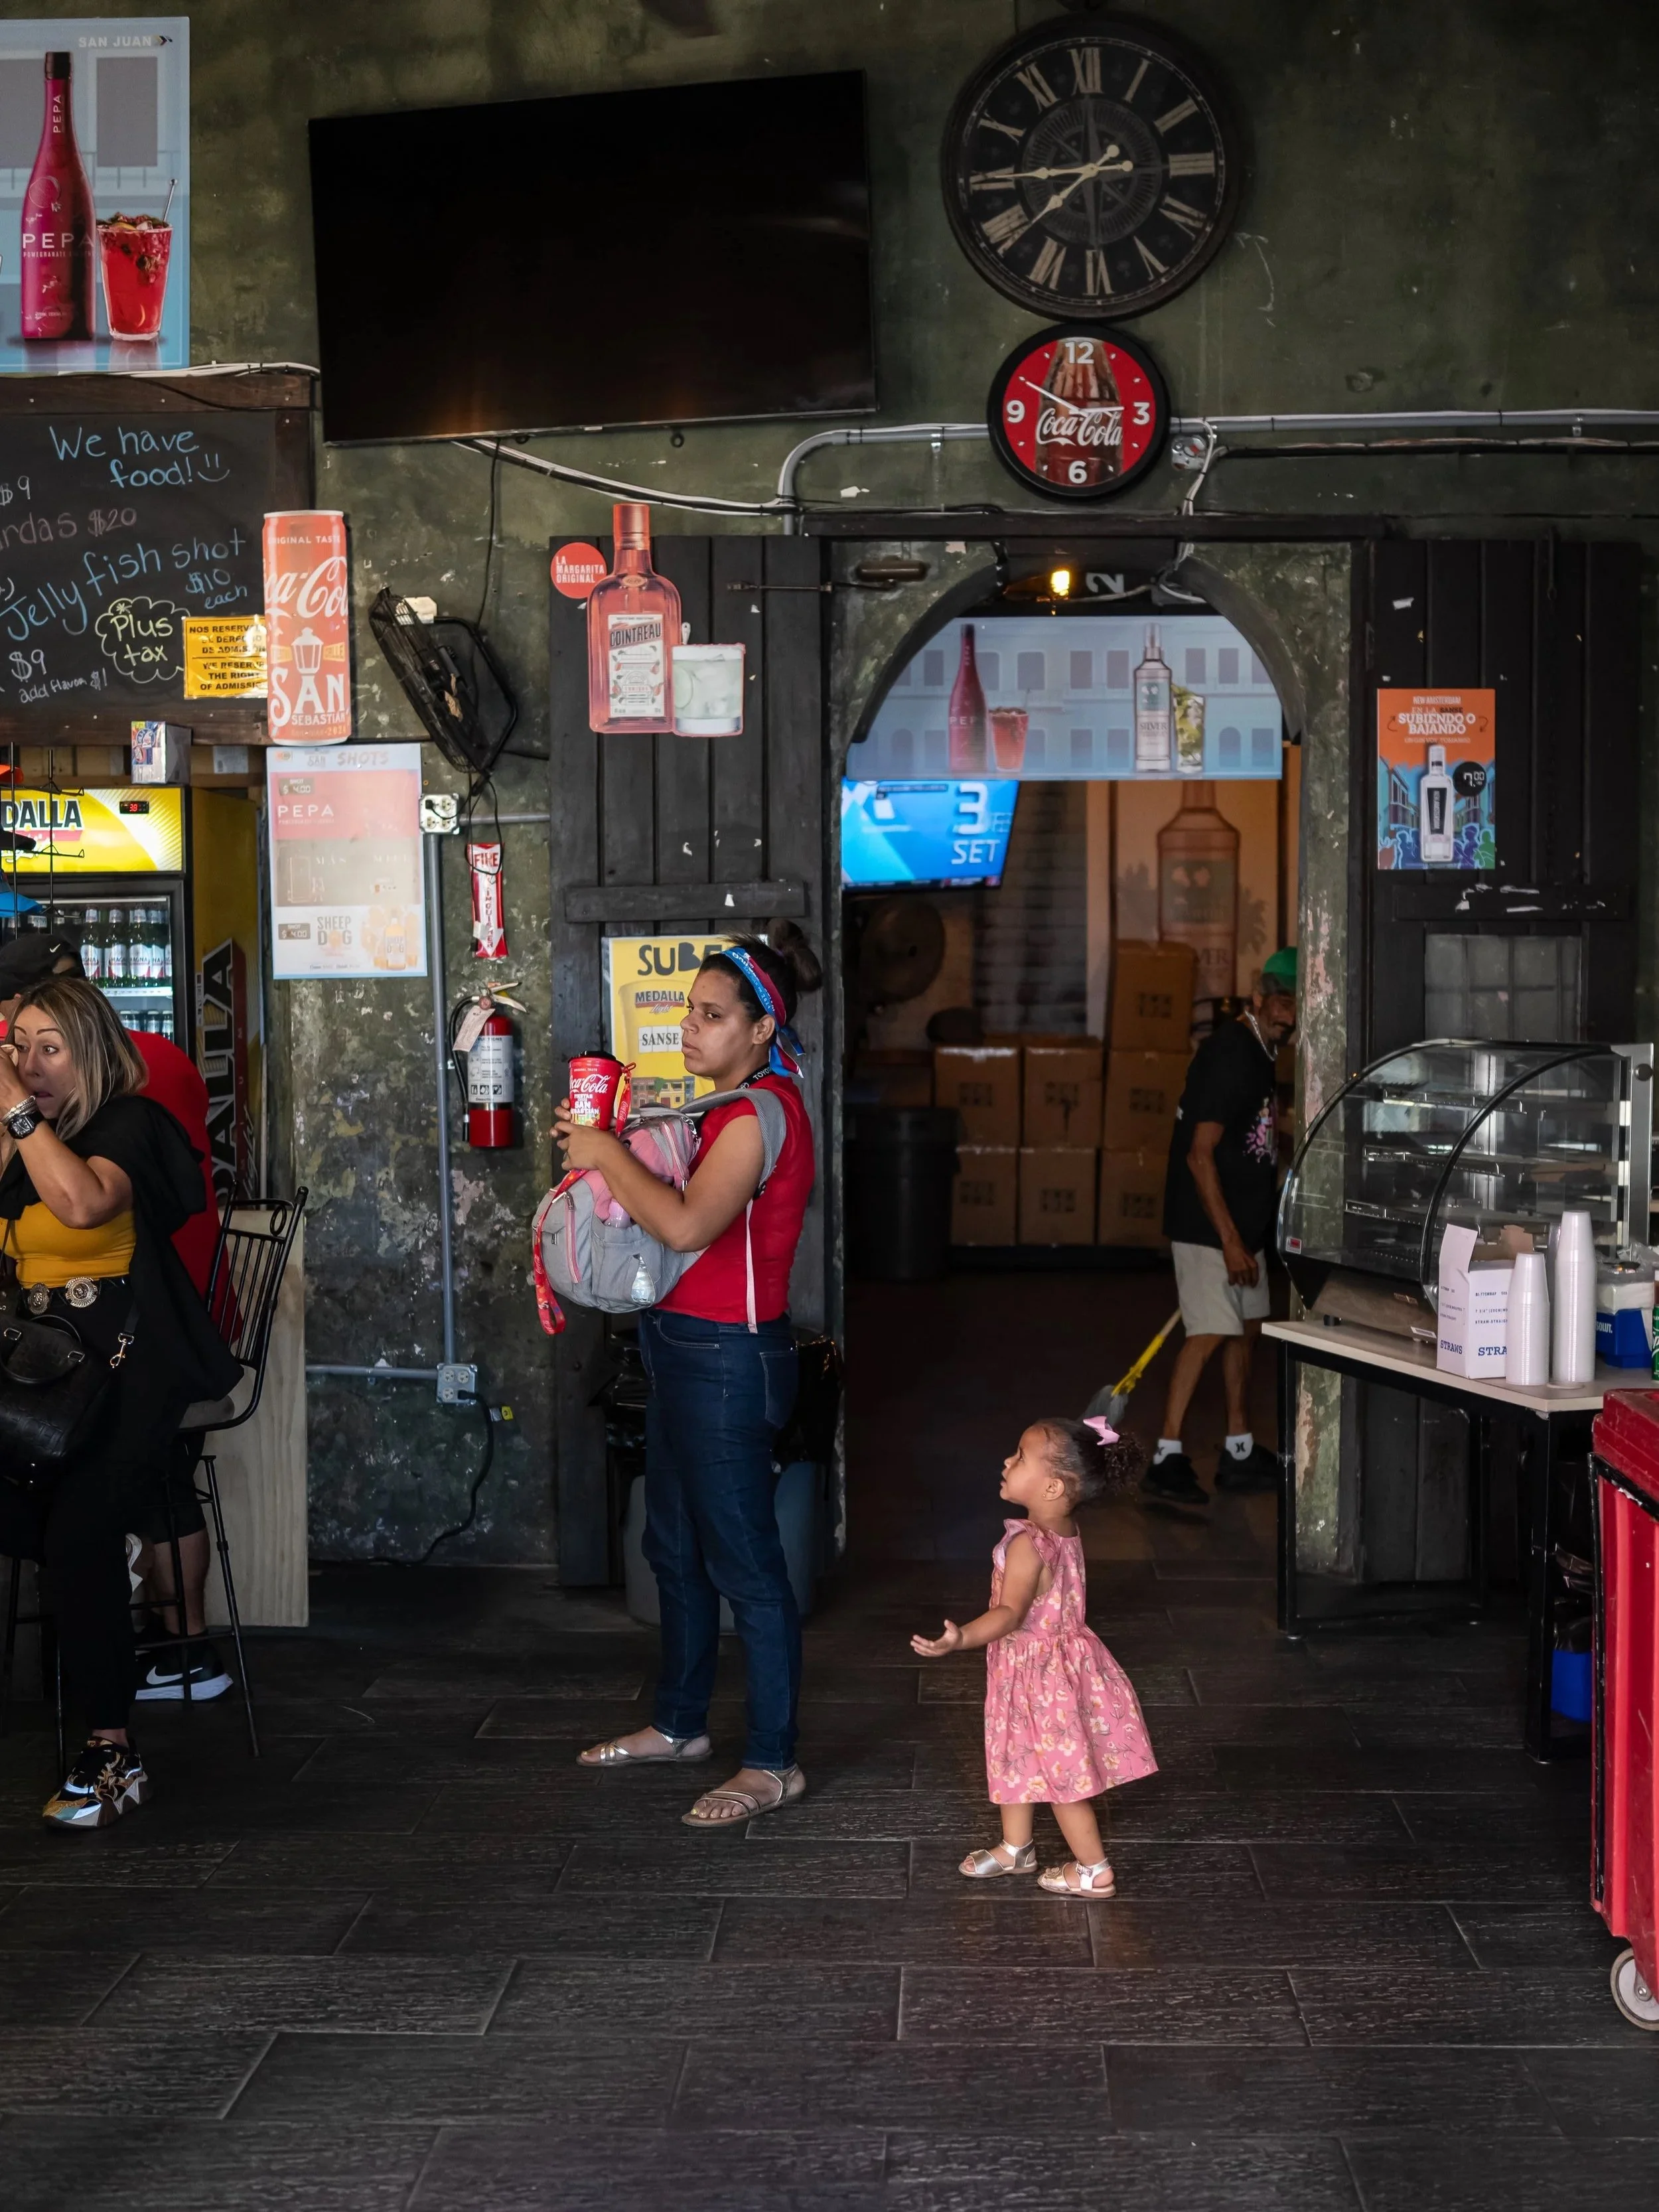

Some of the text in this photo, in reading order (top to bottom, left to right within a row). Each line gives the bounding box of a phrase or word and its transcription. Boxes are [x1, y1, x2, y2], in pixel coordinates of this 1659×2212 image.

[78, 36, 152, 48] SAN JUAN
[23, 233, 94, 248] PEPA
[1065, 341, 1094, 364] 12
[1006, 400, 1025, 423] 9
[1133, 402, 1150, 425] 3
[1036, 407, 1123, 447] Coca-Cola
[49, 426, 199, 461] We have
[110, 456, 192, 488] food!
[1068, 461, 1088, 484] 6
[88, 507, 137, 537] $20
[172, 528, 246, 569] shot
[556, 555, 566, 565] LA
[556, 564, 605, 574] MARGARITA
[556, 573, 595, 583] ORIGINAL
[186, 569, 230, 594] $10
[204, 586, 248, 609] each
[610, 623, 661, 646] COINTREAU
[9, 649, 47, 683] $9
[124, 644, 168, 666] tax
[19, 684, 50, 703] add
[90, 668, 108, 691] $1
[270, 666, 344, 727] SAN
[1398, 713, 1477, 724] SUBIENDO O
[1409, 724, 1467, 735] BAJANDO
[337, 751, 389, 766] SHOTS
[277, 804, 334, 818] PEPA
[958, 782, 988, 834] 3
[474, 853, 498, 867] FIRE
[951, 839, 1000, 864] SET
[317, 916, 351, 929] SHEEP
[635, 990, 685, 1003] MEDALLA
[650, 1003, 673, 1015] Light
[642, 1033, 679, 1046] SANSE
[1441, 1340, 1463, 1355] STRAWS
